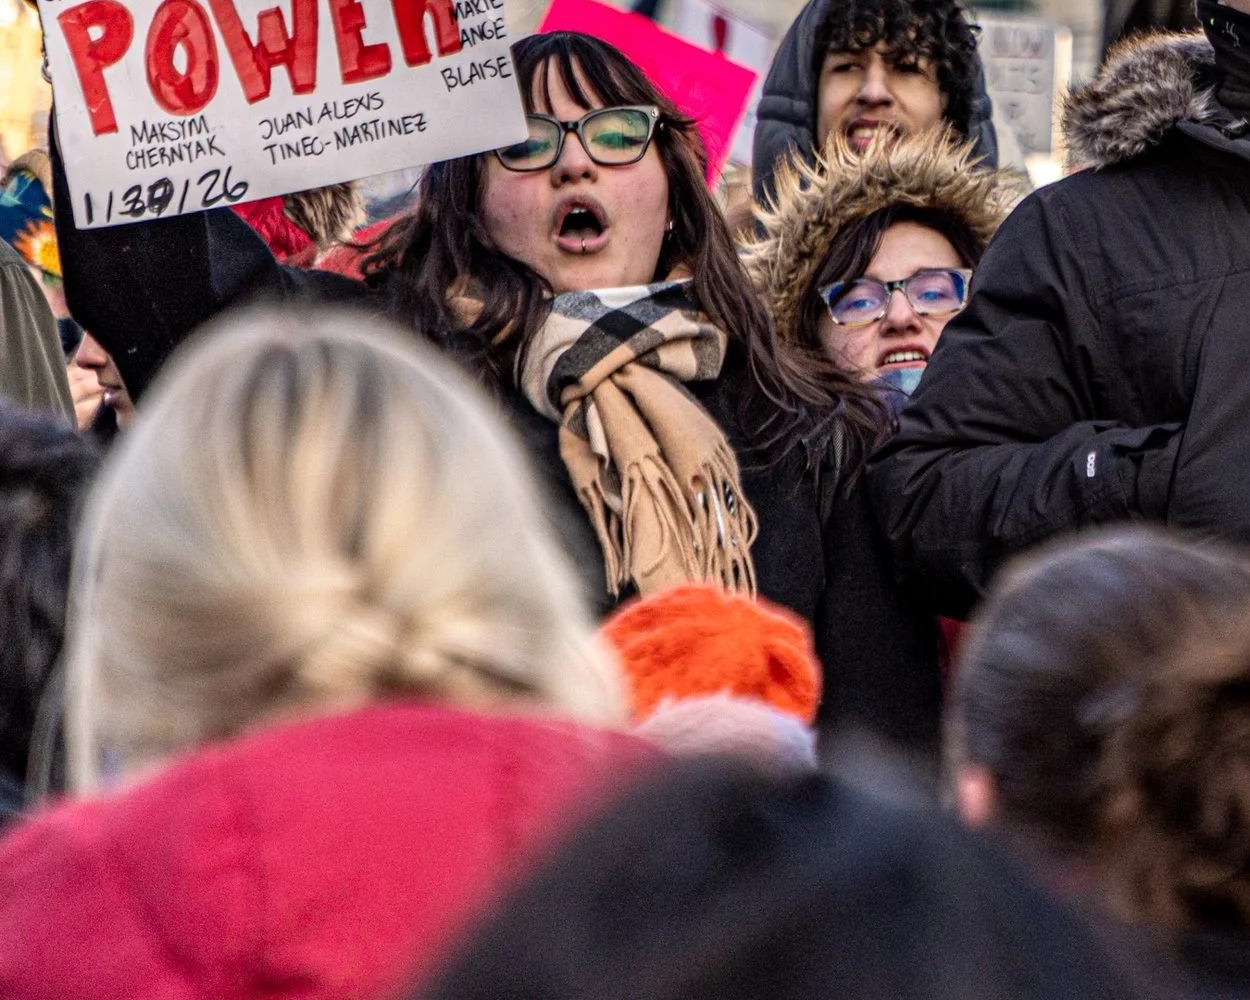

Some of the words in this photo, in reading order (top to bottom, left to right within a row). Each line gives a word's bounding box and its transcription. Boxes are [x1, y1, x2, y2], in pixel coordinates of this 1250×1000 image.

[461, 17, 506, 47] ANGE
[440, 56, 512, 92] BLAISE
[130, 115, 209, 147] MAKSYM
[258, 107, 312, 140] JUAN
[317, 91, 384, 123] ALEXIS
[126, 135, 226, 170] CHERNYAK
